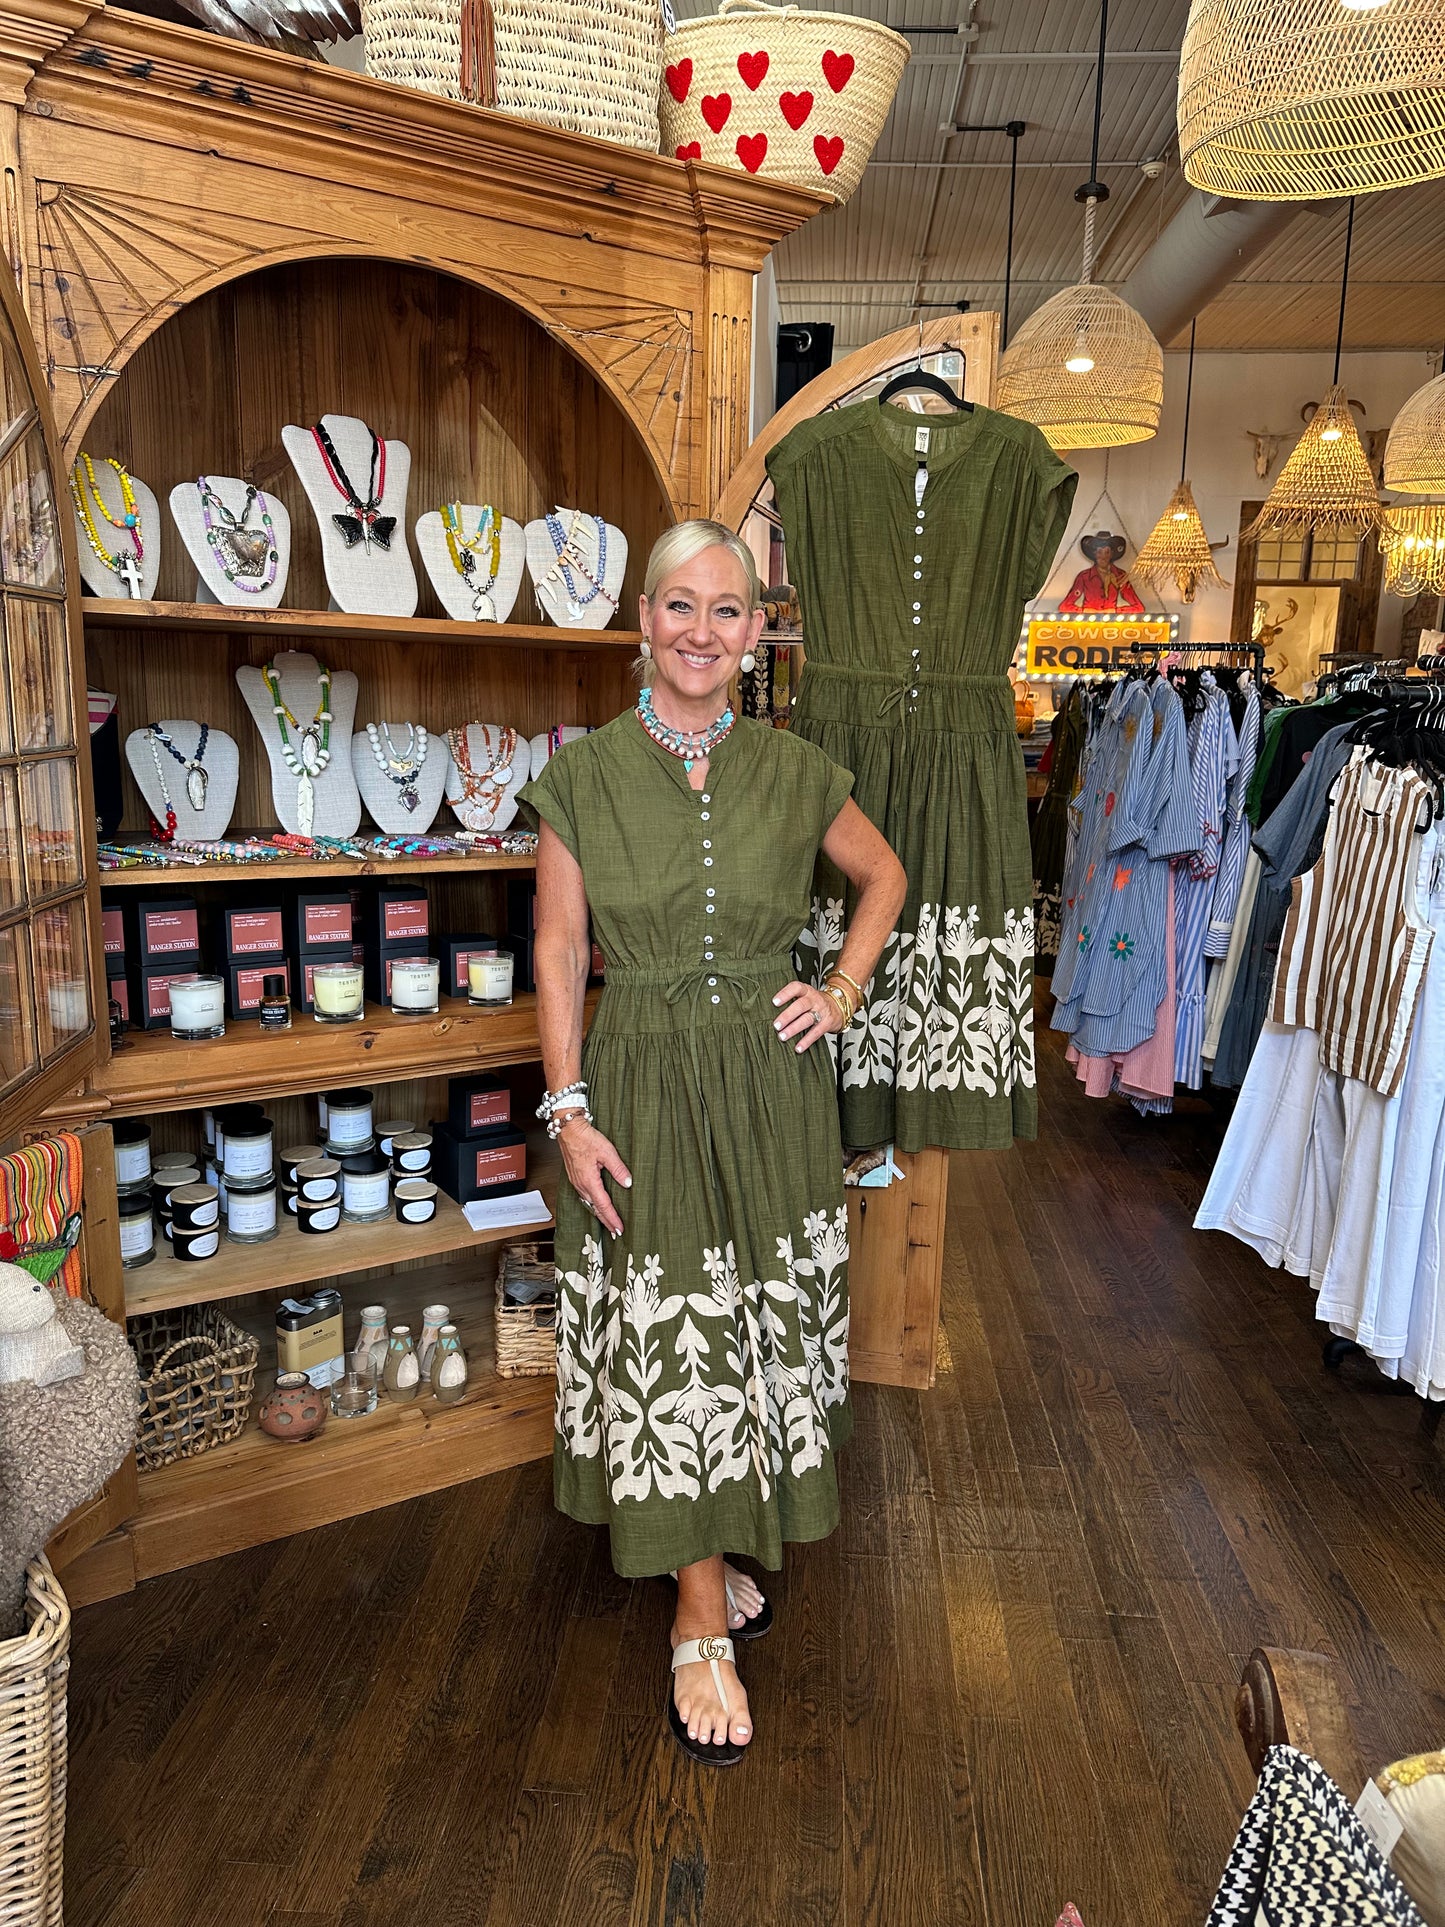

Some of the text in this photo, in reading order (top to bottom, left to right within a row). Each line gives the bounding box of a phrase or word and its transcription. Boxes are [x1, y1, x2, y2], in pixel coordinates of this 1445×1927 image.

[1036, 627, 1164, 641] COWBOY
[388, 929, 408, 937] RANGER
[408, 927, 427, 935] STATION
[308, 933, 329, 941] RANGER
[104, 942, 121, 951] ATION
[150, 943, 173, 951] RANGER
[173, 940, 196, 949] STATION
[235, 943, 257, 951] RANGER
[257, 941, 279, 949] STATION
[242, 998, 260, 1007] RANGE
[152, 1006, 171, 1015] RANGE
[473, 1117, 491, 1125] RANGER
[479, 1175, 498, 1185] RANGER
[498, 1172, 517, 1182] STATION
